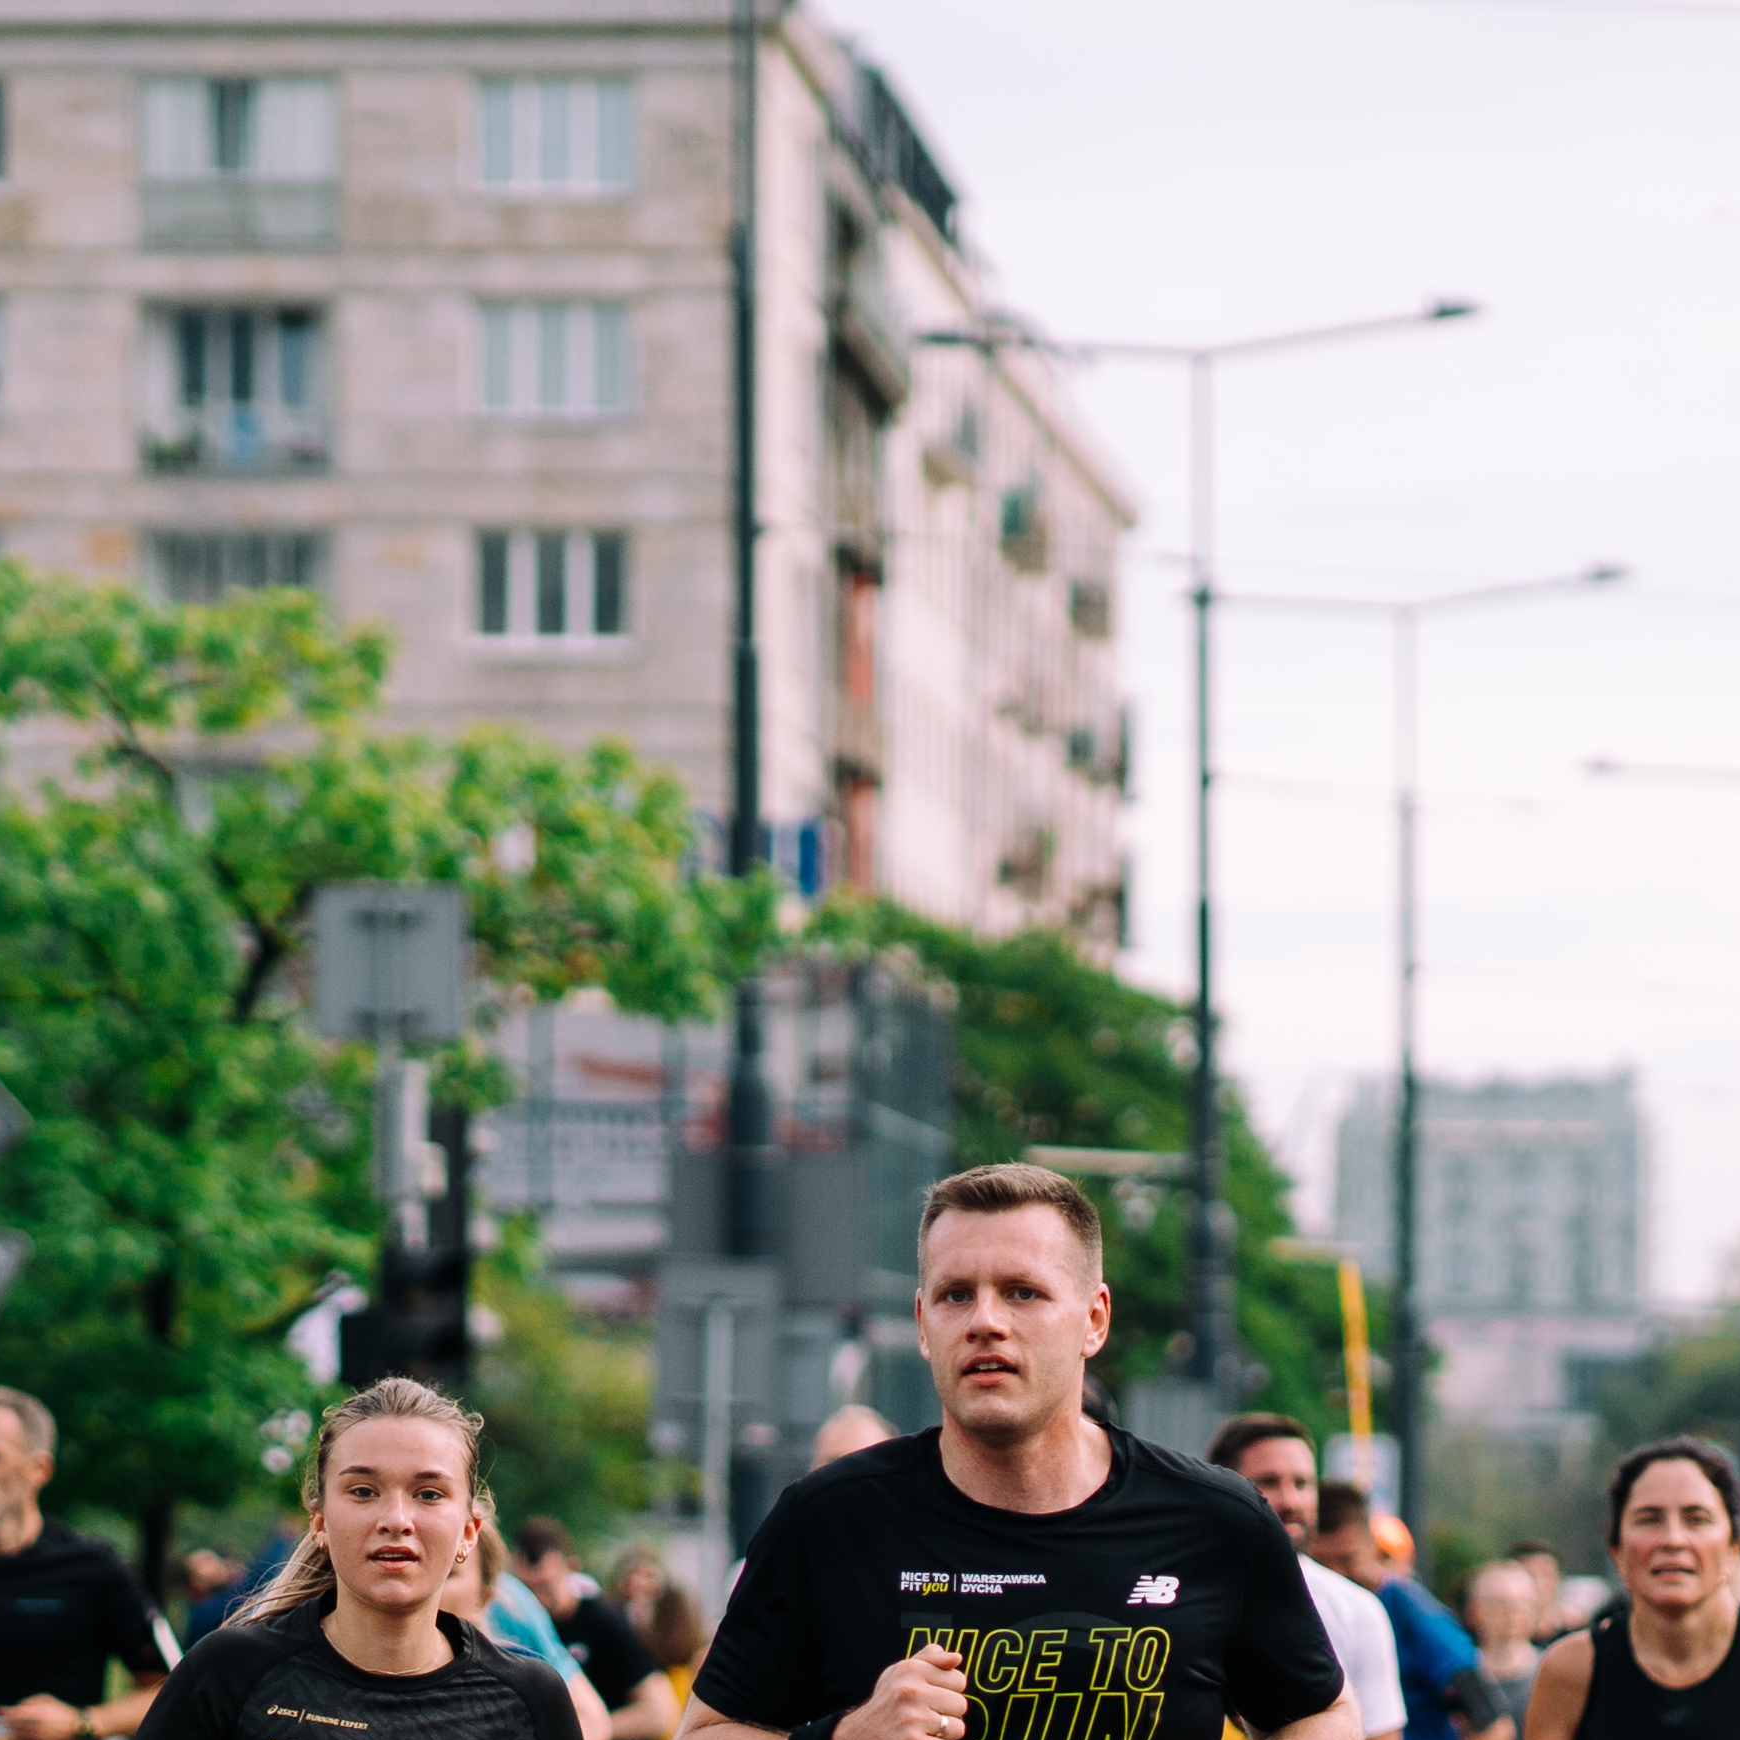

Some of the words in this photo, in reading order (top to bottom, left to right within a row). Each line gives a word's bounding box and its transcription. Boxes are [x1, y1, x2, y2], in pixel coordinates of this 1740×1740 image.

[901, 1571, 931, 1582] NICE
[932, 1572, 950, 1582] TO
[961, 1573, 1047, 1584] WARSZAWSKA
[900, 1581, 922, 1591] FIT
[922, 1582, 948, 1596] you
[961, 1583, 1003, 1594] DYCHA
[1089, 1627, 1170, 1692] TO
[340, 1719, 368, 1730] EXPERT
